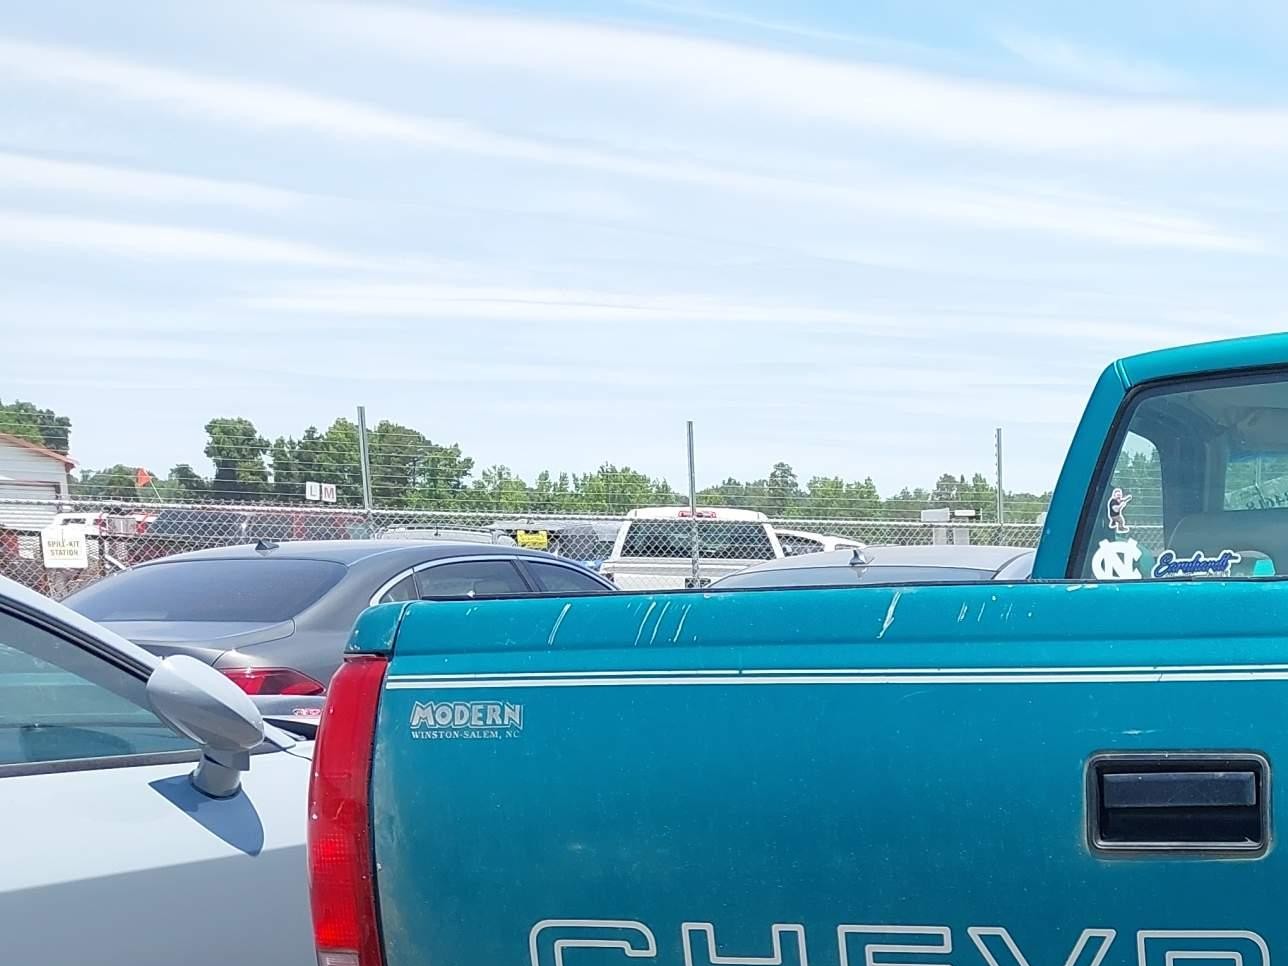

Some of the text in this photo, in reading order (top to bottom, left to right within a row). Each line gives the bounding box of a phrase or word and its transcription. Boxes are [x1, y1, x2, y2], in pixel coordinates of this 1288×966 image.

[324, 487, 335, 499] M
[410, 701, 523, 730] MODERN
[411, 730, 520, 740] WINSTON-SALEM, NC
